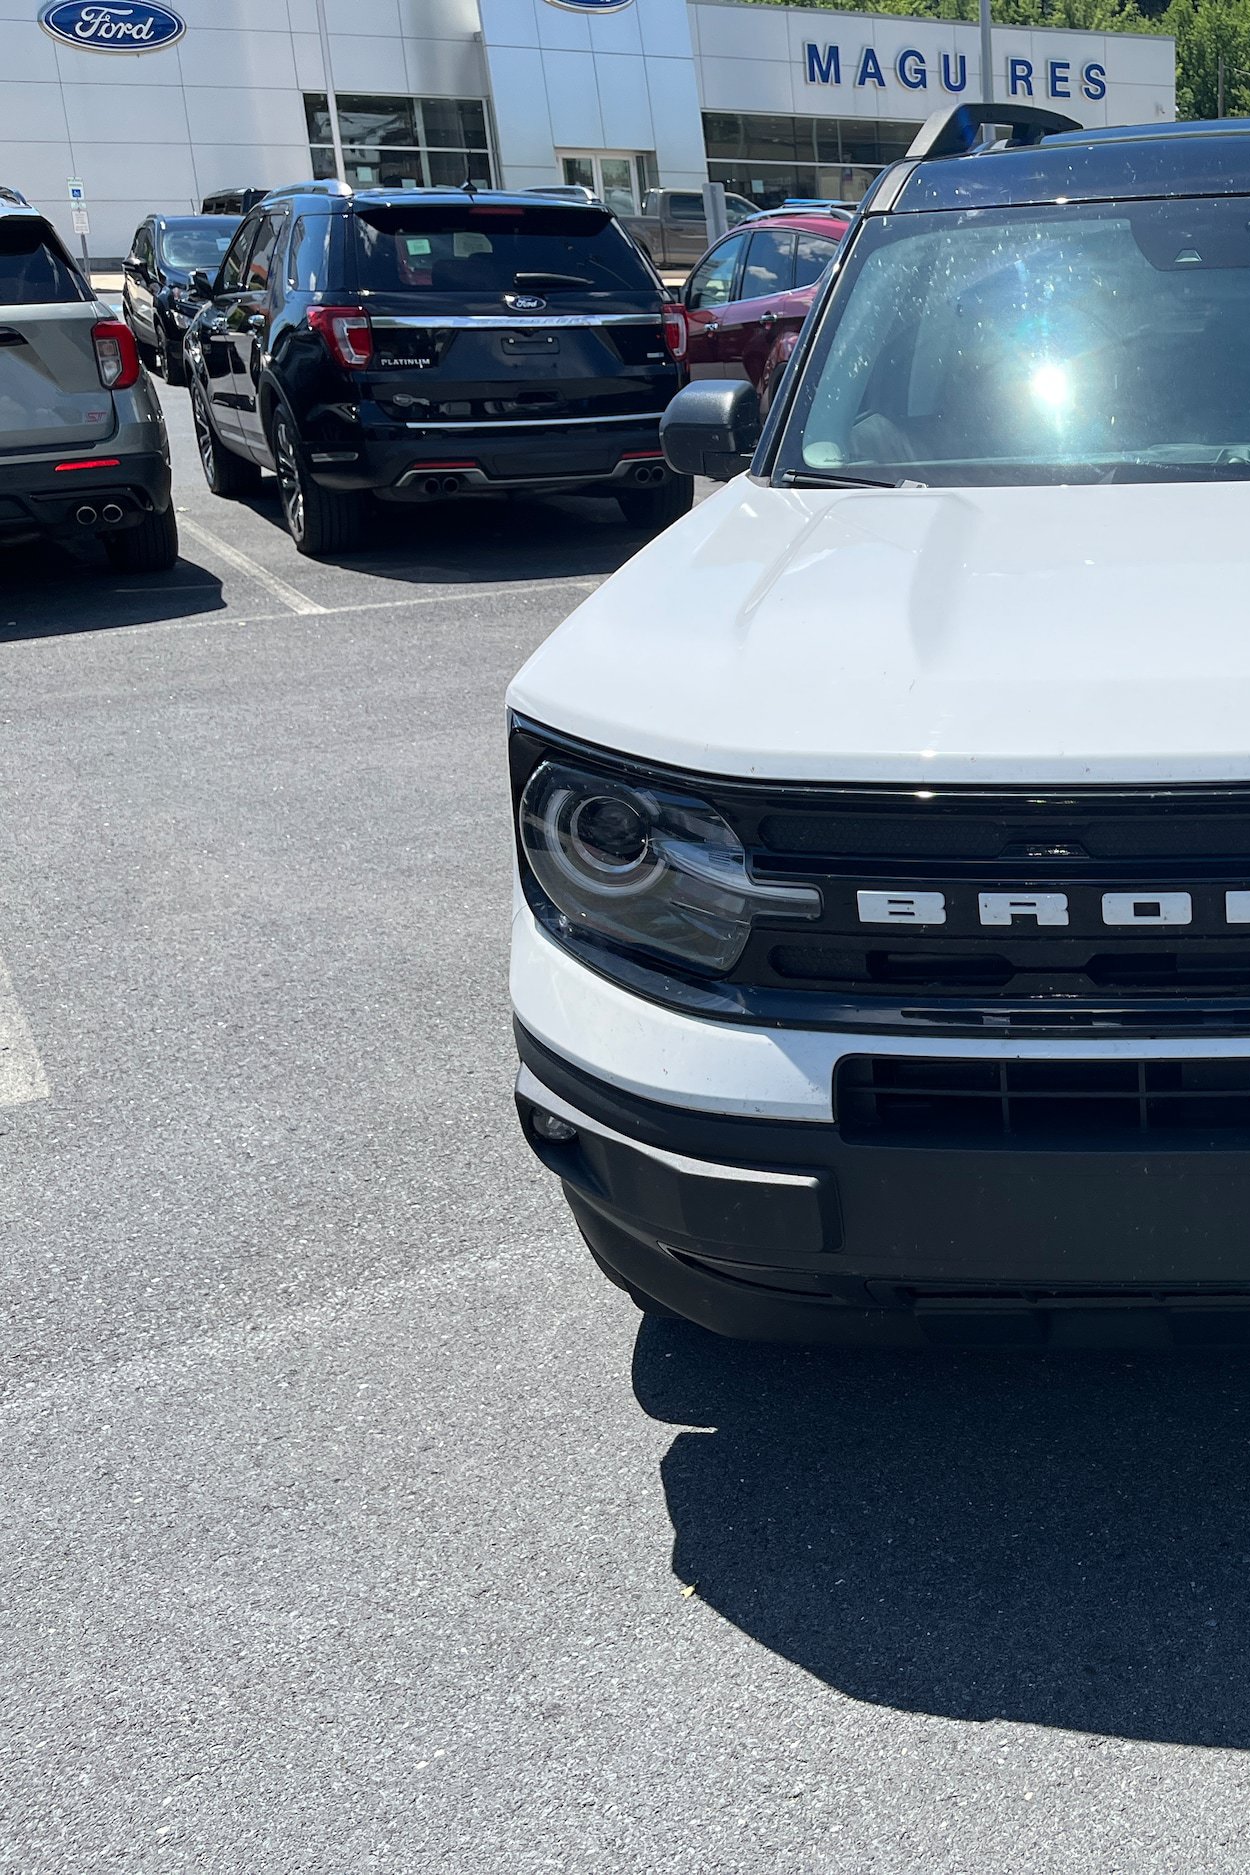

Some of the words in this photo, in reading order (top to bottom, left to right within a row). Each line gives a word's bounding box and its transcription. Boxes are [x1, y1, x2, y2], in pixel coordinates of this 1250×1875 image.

[74, 6, 155, 40] Ford
[804, 41, 1107, 101] MAGURES
[516, 298, 538, 308] Ford
[380, 358, 430, 366] PLATINUM
[87, 411, 107, 423] ST
